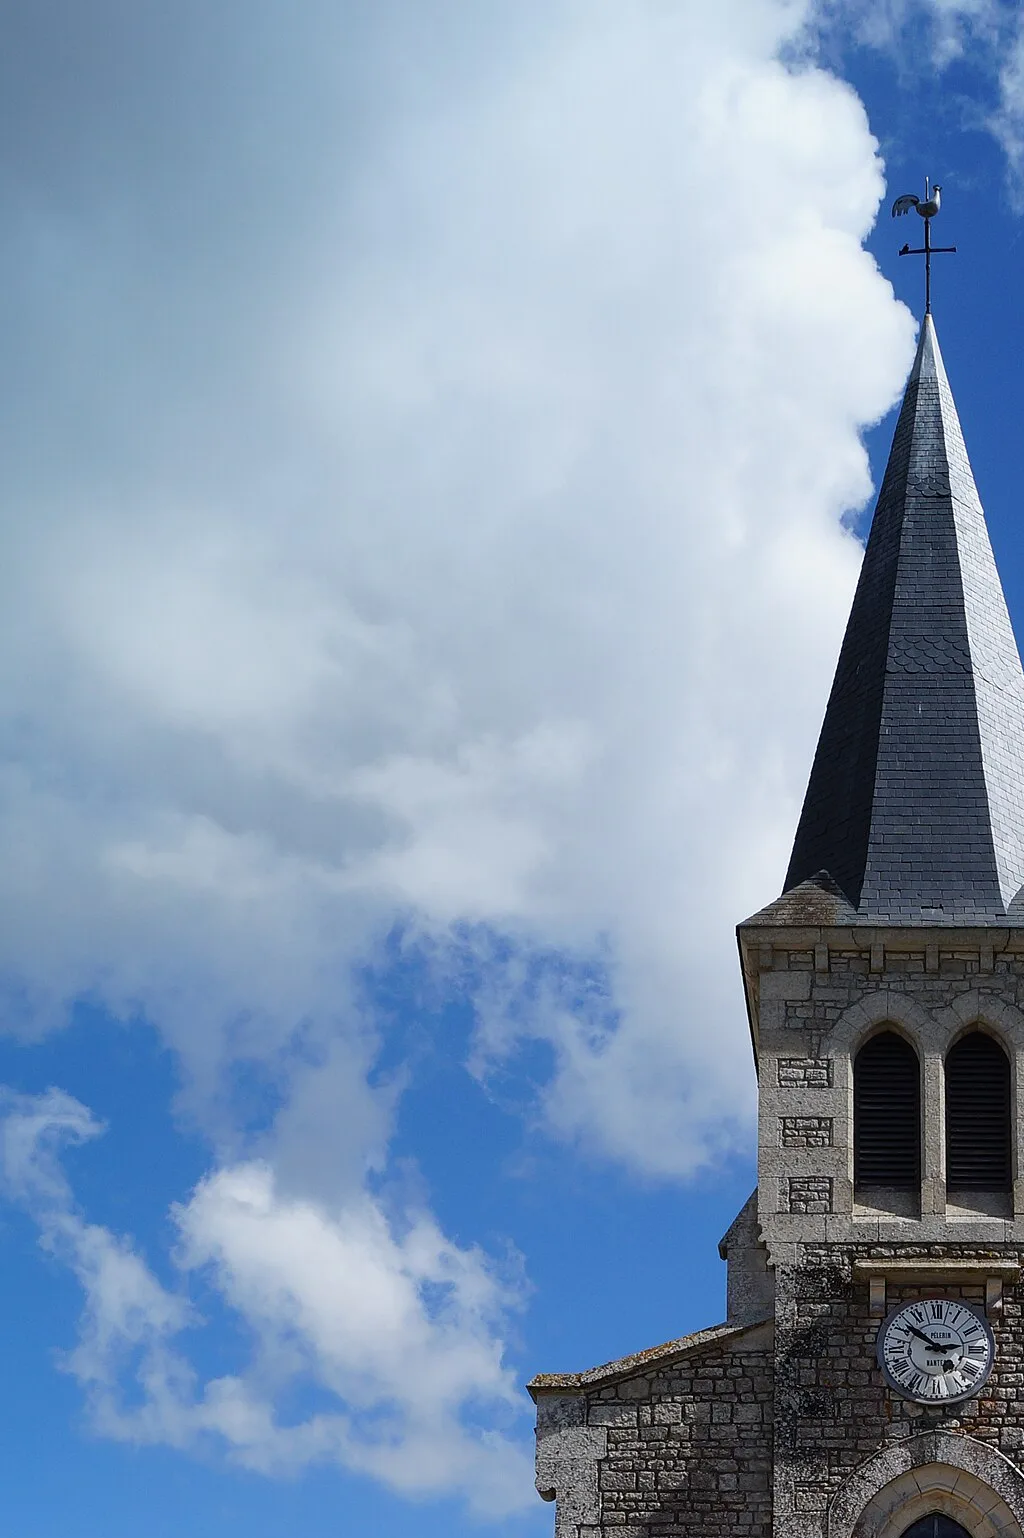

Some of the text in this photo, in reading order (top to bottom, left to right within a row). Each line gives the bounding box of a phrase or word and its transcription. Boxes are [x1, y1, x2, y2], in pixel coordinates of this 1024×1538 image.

[931, 1304, 943, 1319] XII
[951, 1310, 961, 1324] I
[963, 1325, 978, 1336] II
[968, 1345, 984, 1355] III
[926, 1359, 945, 1367] NANTE
